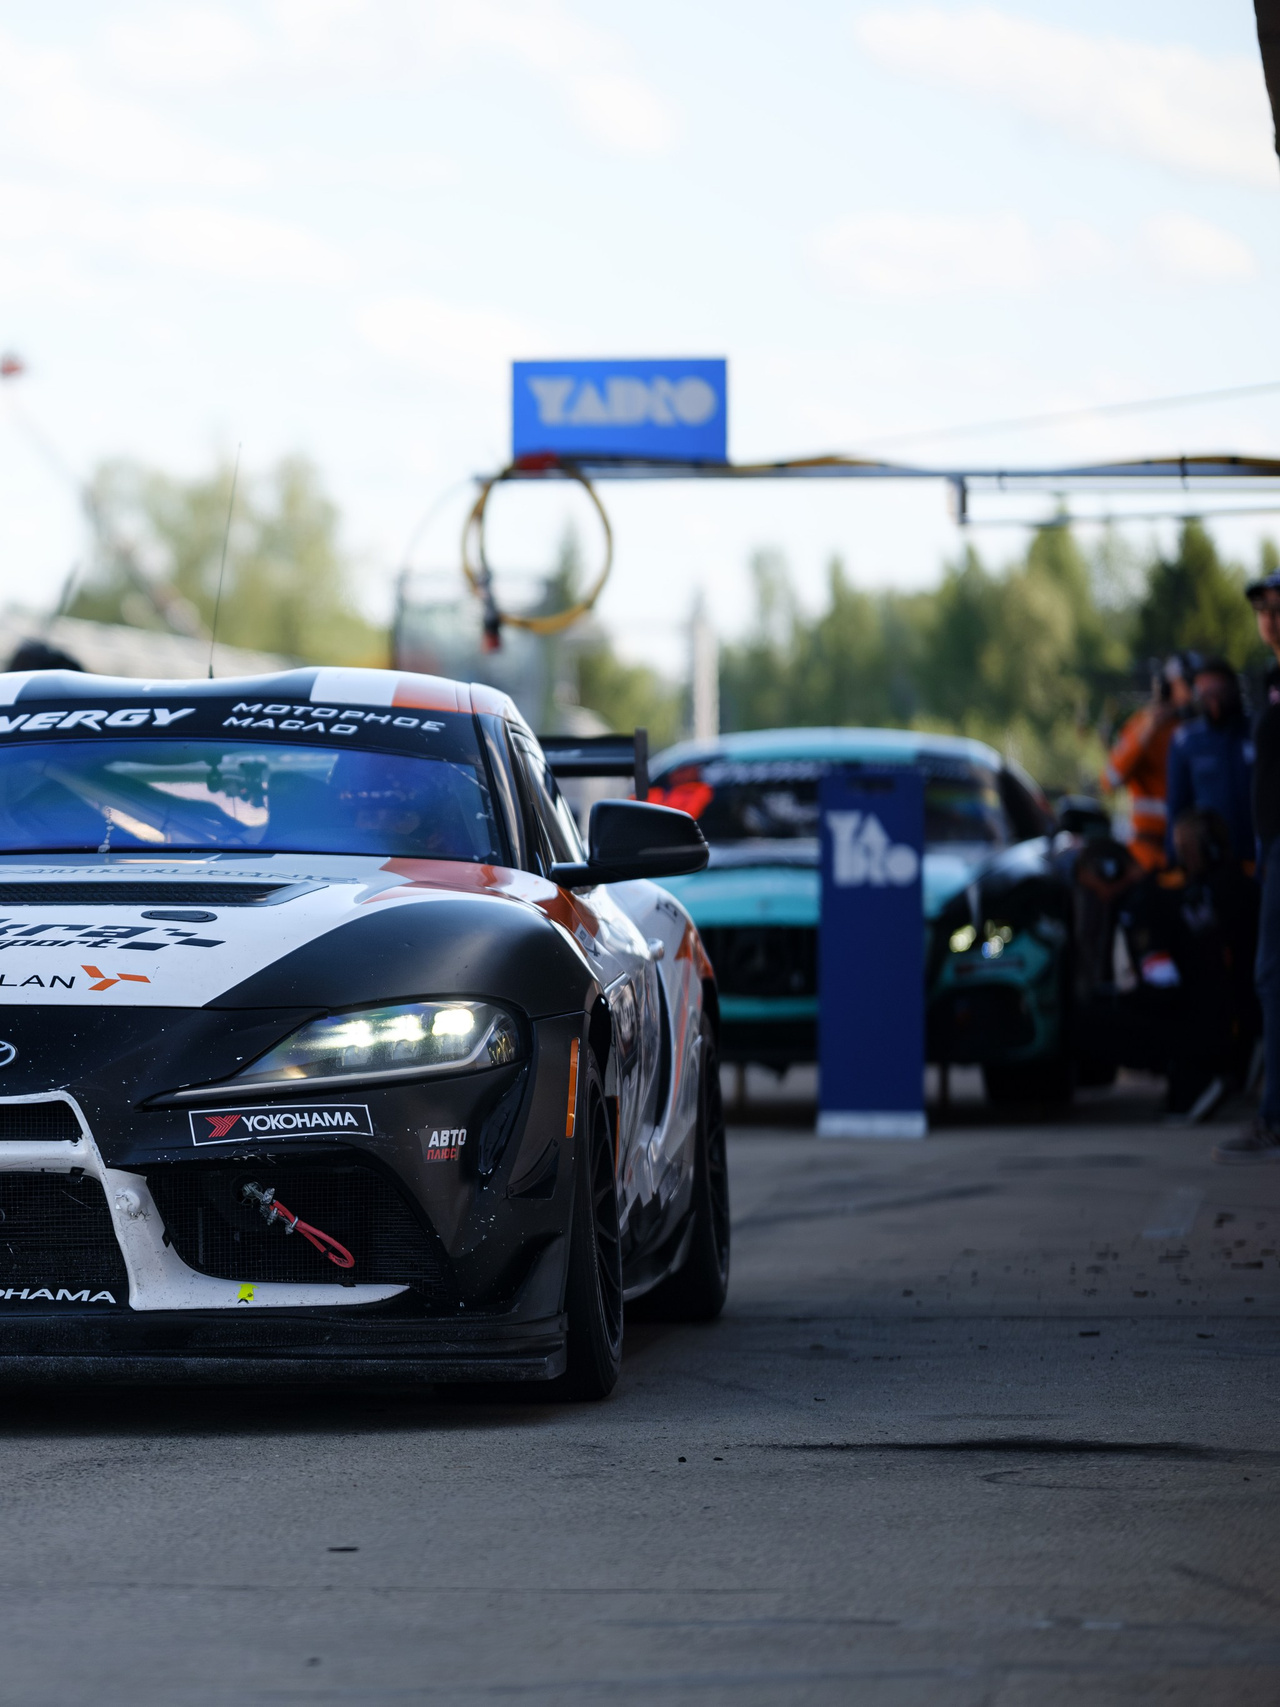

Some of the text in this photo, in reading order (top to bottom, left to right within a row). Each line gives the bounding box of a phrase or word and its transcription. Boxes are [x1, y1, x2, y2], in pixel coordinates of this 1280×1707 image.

[222, 716, 359, 735] МАСЛО
[231, 702, 446, 732] МОТОРНОЕ
[240, 1111, 359, 1132] YOKOHAMA
[428, 1128, 467, 1148] АВТО
